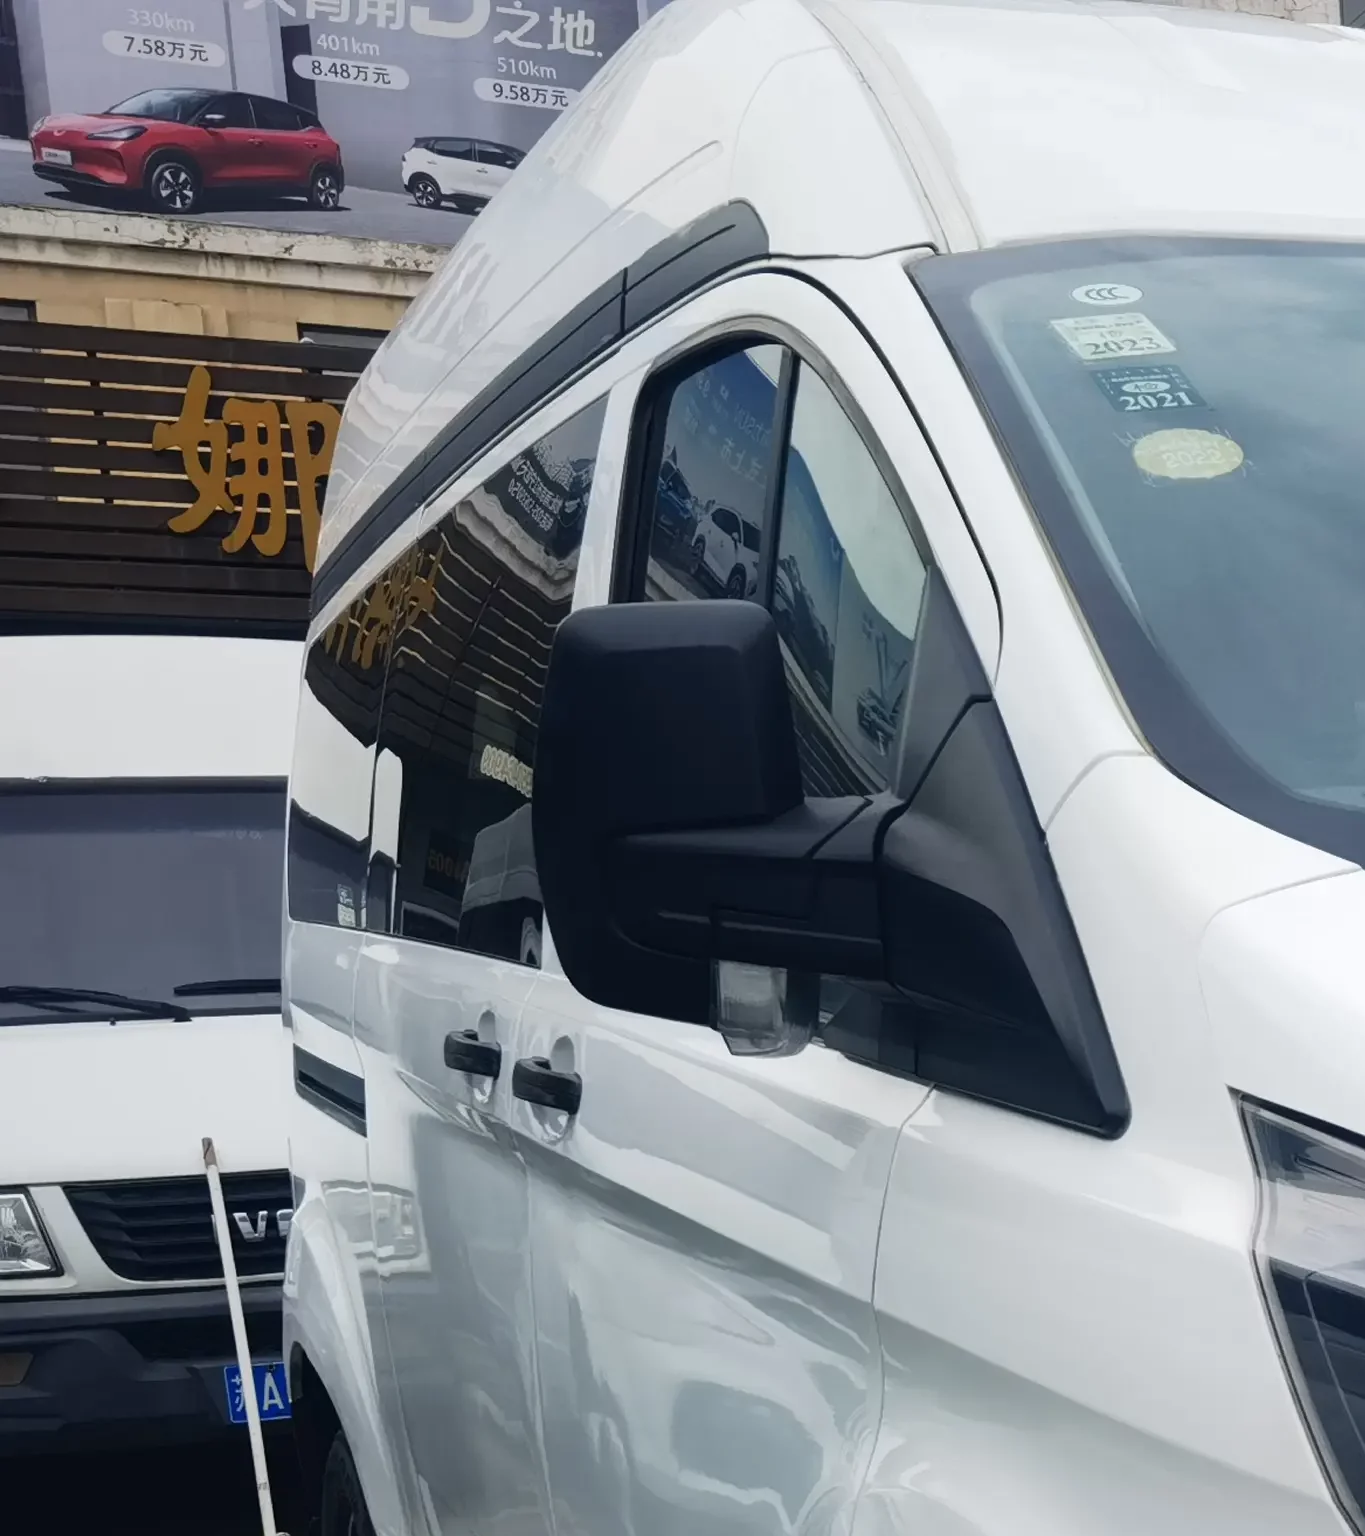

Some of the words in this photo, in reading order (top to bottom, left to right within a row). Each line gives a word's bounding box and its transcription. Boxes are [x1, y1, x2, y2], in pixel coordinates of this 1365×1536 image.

[127, 8, 196, 33] 330km
[123, 35, 209, 63] 7.58万元
[316, 33, 380, 56] 401km
[311, 60, 391, 86] 8.48万元
[497, 56, 557, 80] 510km
[492, 82, 569, 108] 9.58万元
[1084, 336, 1162, 356] 2023
[1119, 391, 1196, 411] 2021
